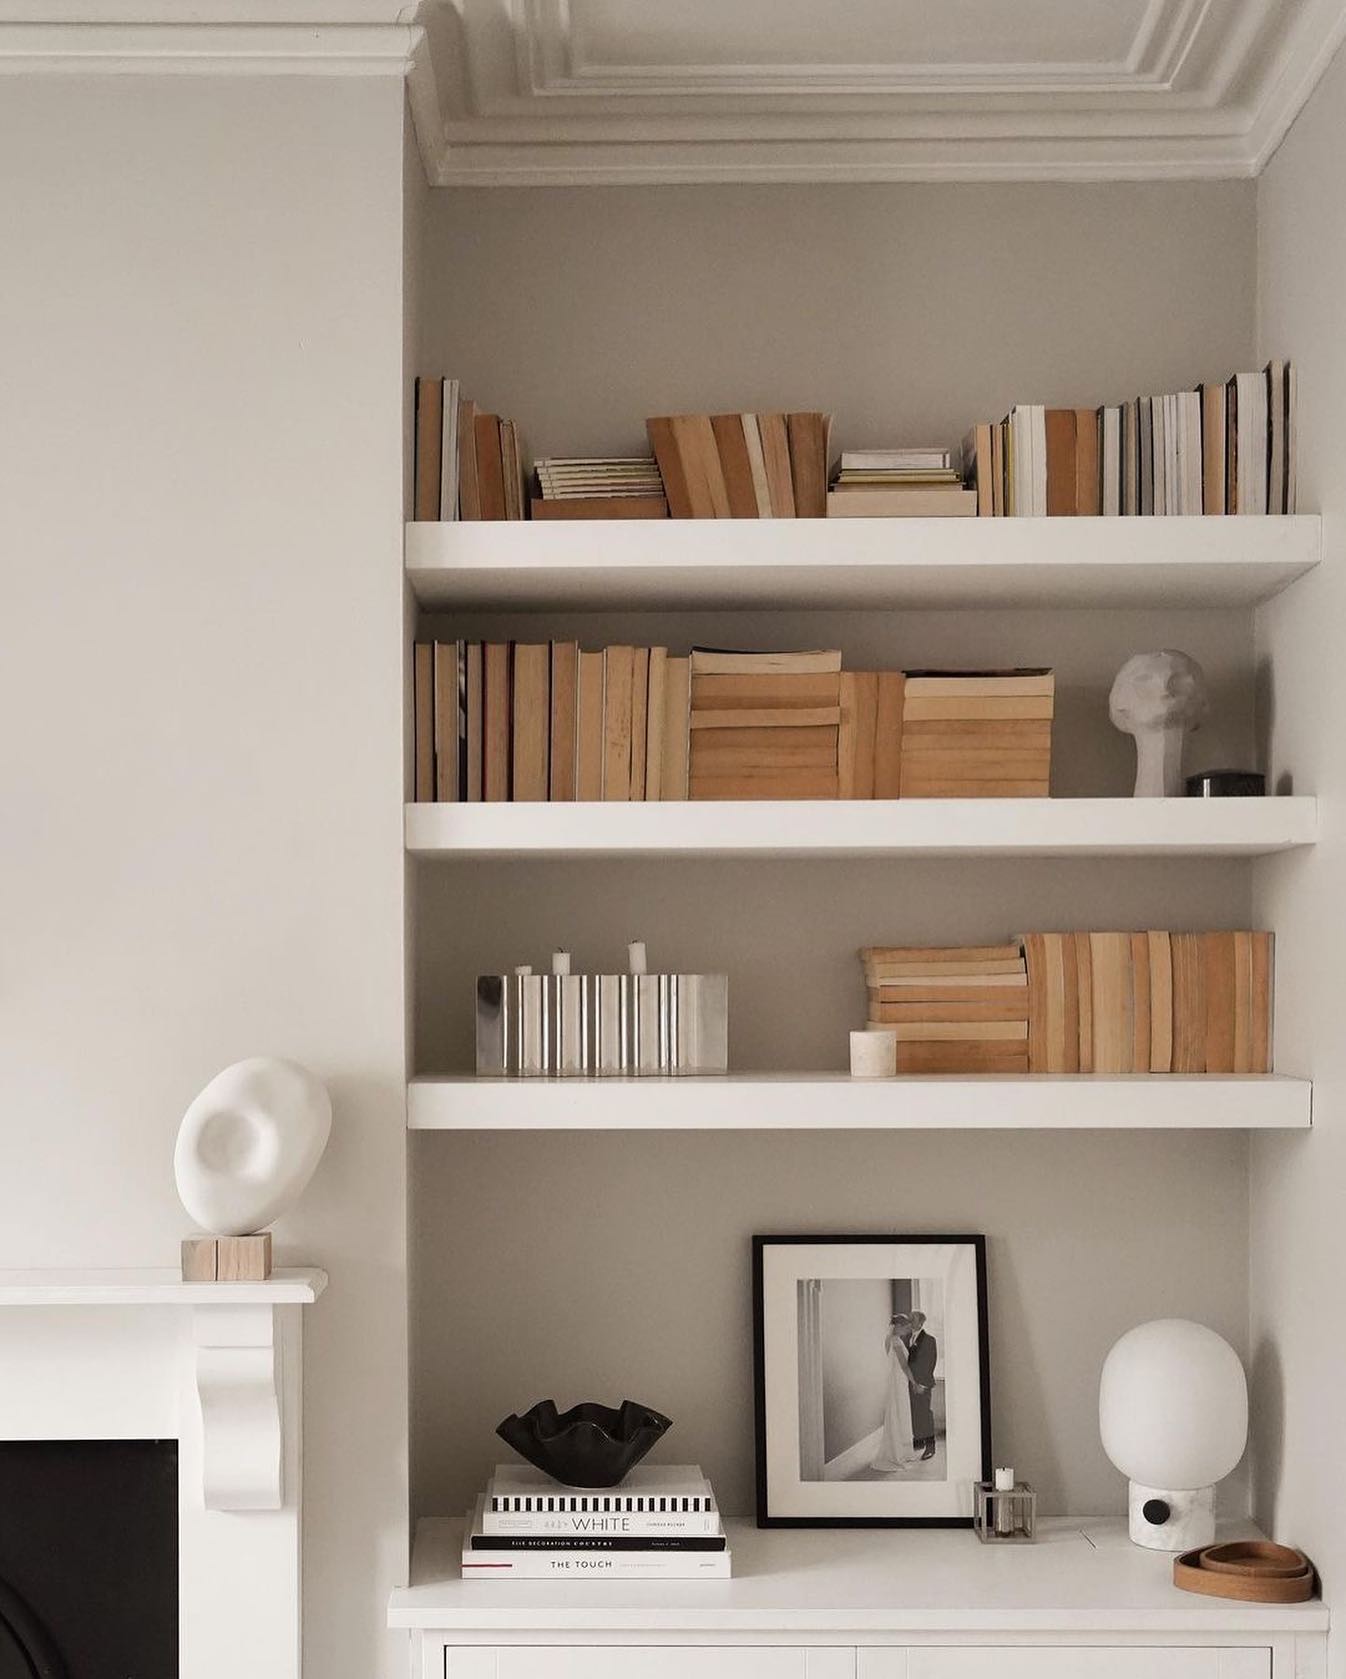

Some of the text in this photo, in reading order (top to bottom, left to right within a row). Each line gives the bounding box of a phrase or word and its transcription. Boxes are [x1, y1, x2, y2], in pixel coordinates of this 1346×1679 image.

[571, 1517, 630, 1531] WHITE
[551, 1561, 570, 1569] THE
[575, 1561, 612, 1569] TOUCH
